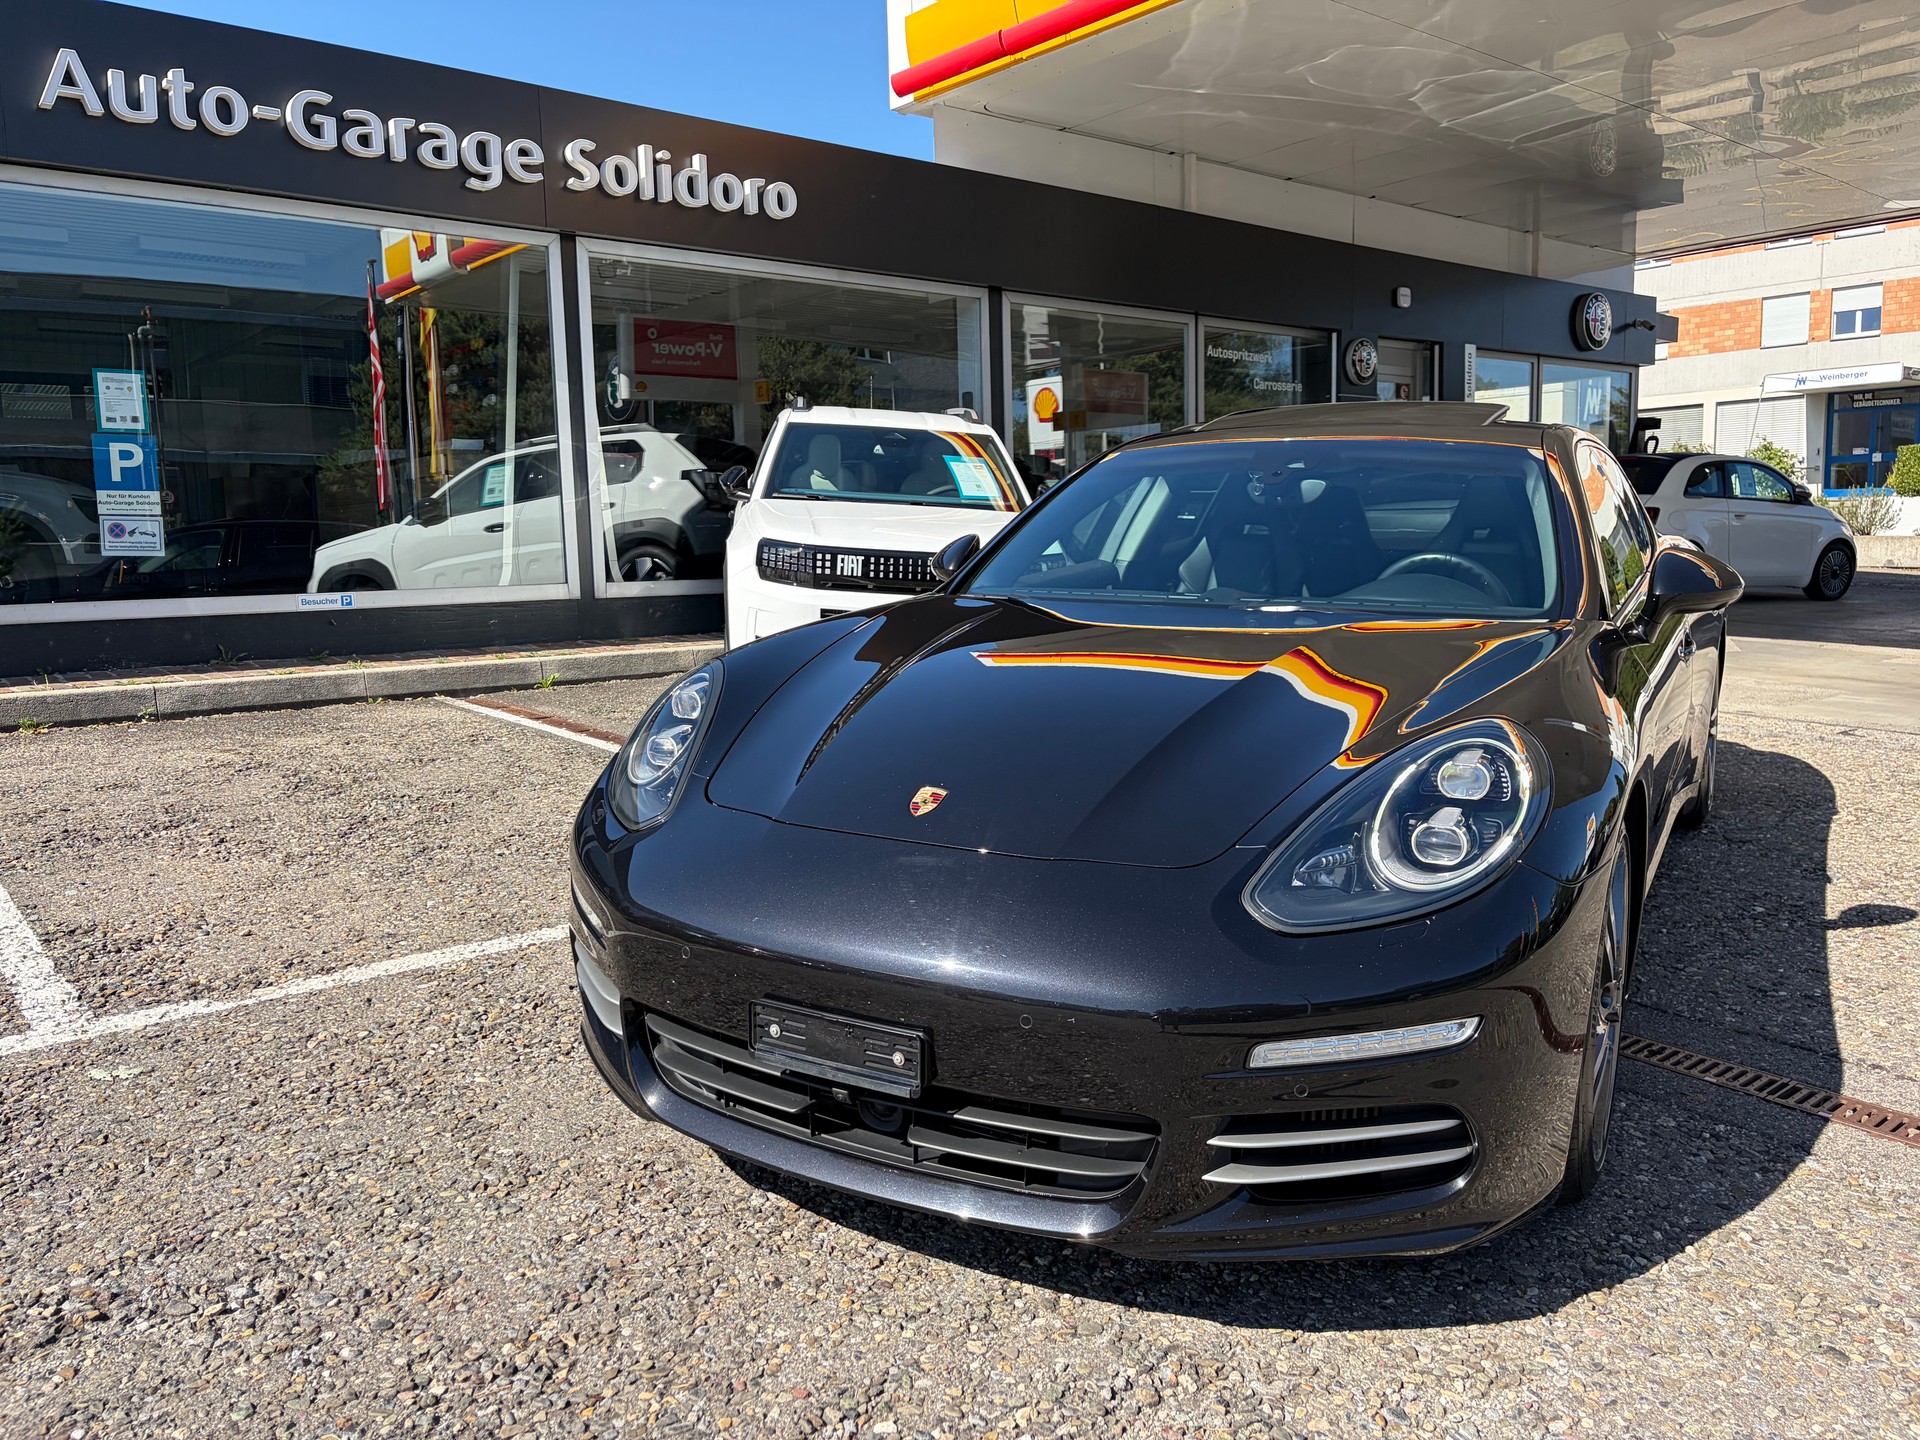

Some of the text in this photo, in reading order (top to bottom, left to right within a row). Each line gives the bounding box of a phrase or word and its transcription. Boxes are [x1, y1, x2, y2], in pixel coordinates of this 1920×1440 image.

[38, 47, 798, 220] Auto-Garage Solidoro
[1206, 344, 1273, 363] Autospritzwerk
[1253, 378, 1302, 392] Carrosserie
[1819, 371, 1868, 381] Weinberger
[109, 442, 144, 482] P
[836, 554, 865, 577] FIAT
[301, 597, 339, 606] Besucher
